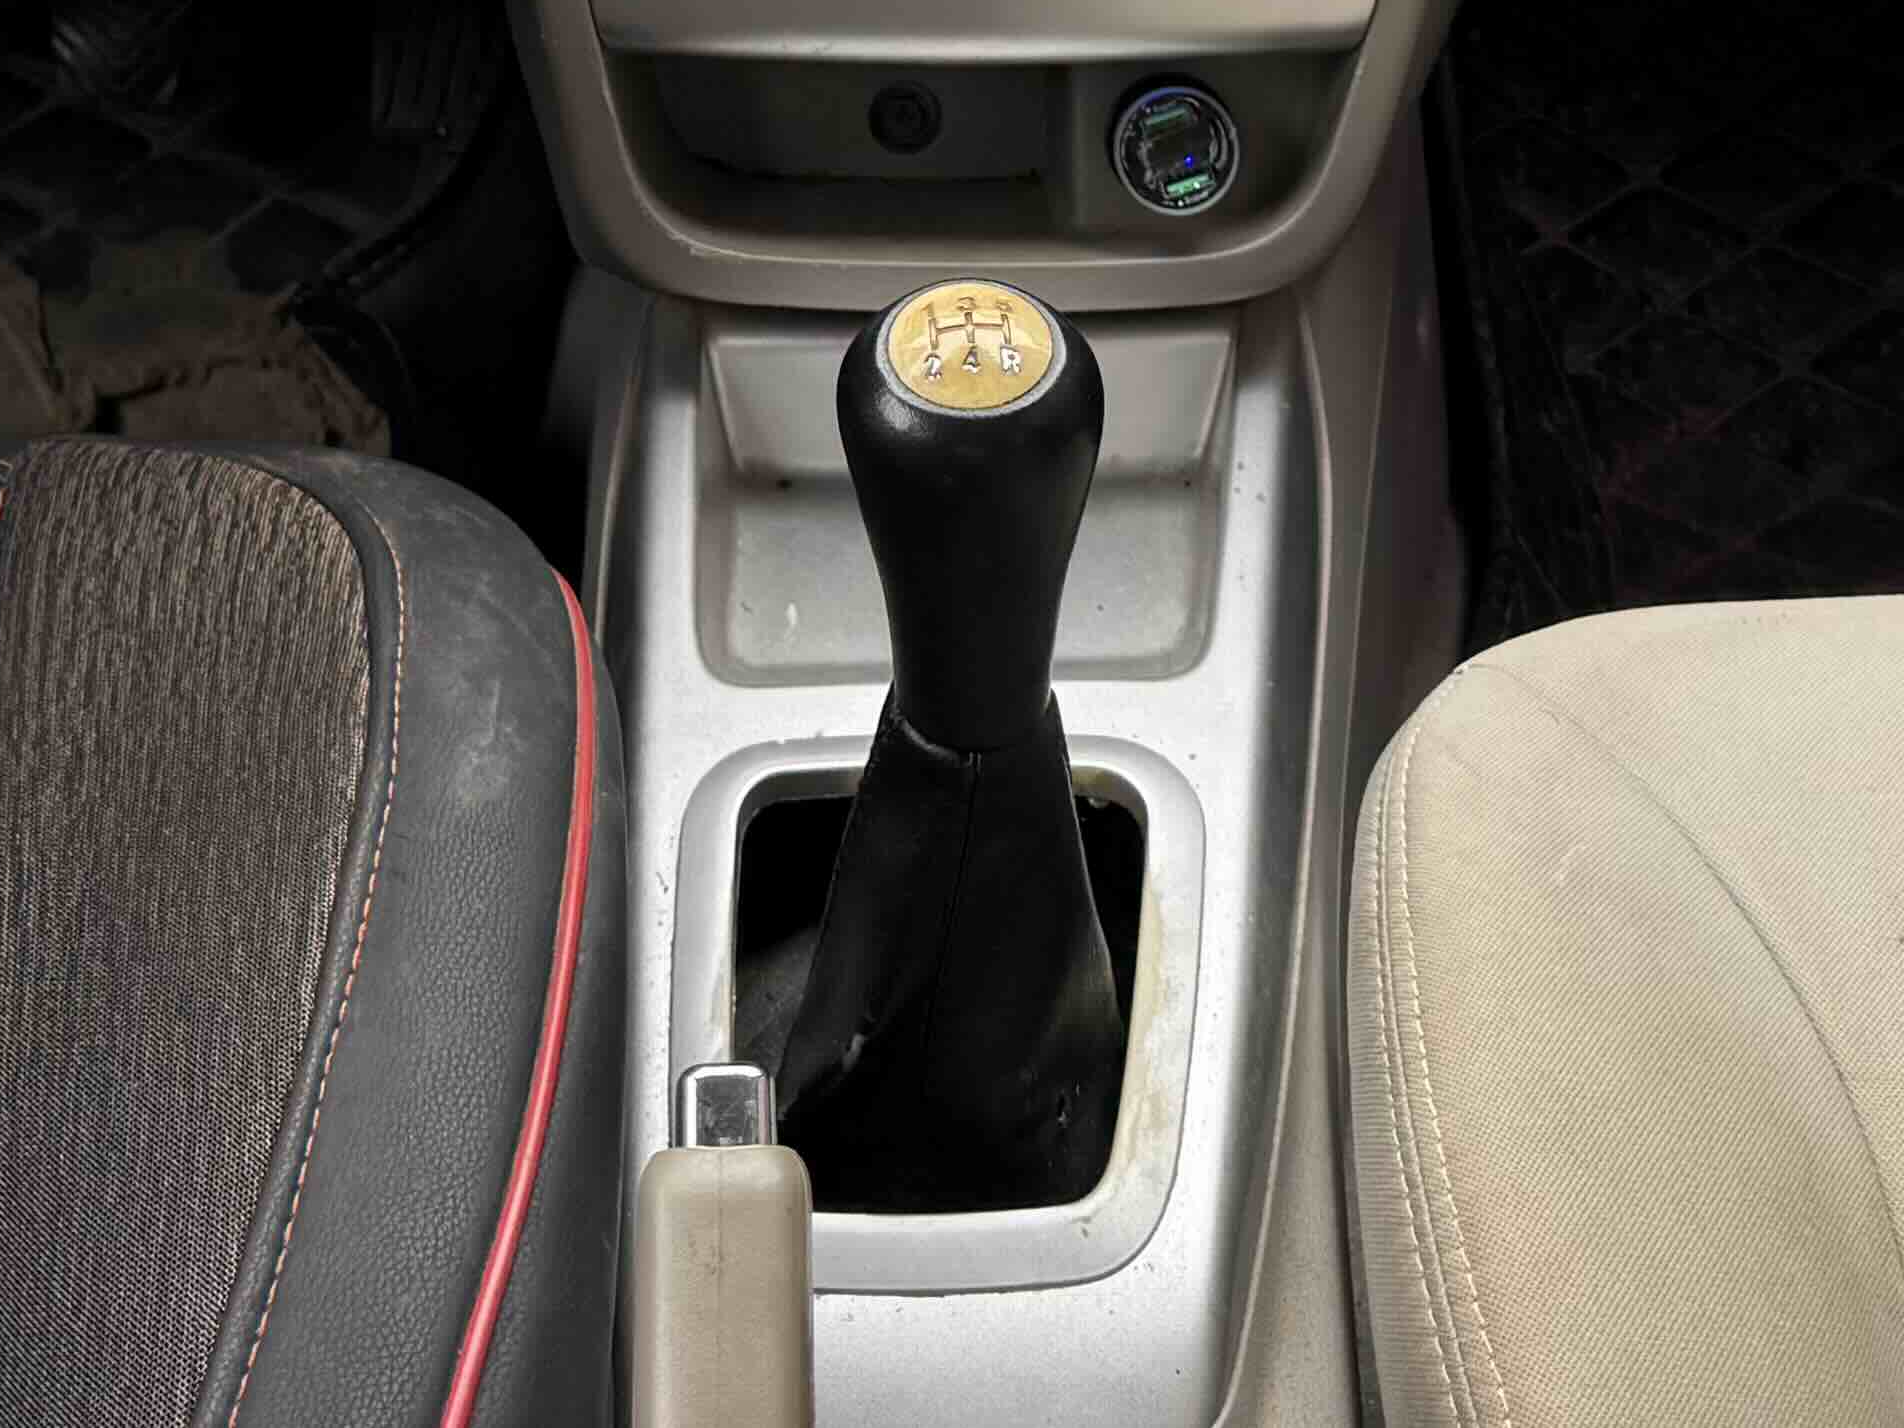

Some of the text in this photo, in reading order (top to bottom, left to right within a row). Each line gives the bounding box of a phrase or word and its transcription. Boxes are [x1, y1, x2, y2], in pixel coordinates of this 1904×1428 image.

[957, 296, 976, 311] 3
[924, 345, 1021, 383] 2 4 R
